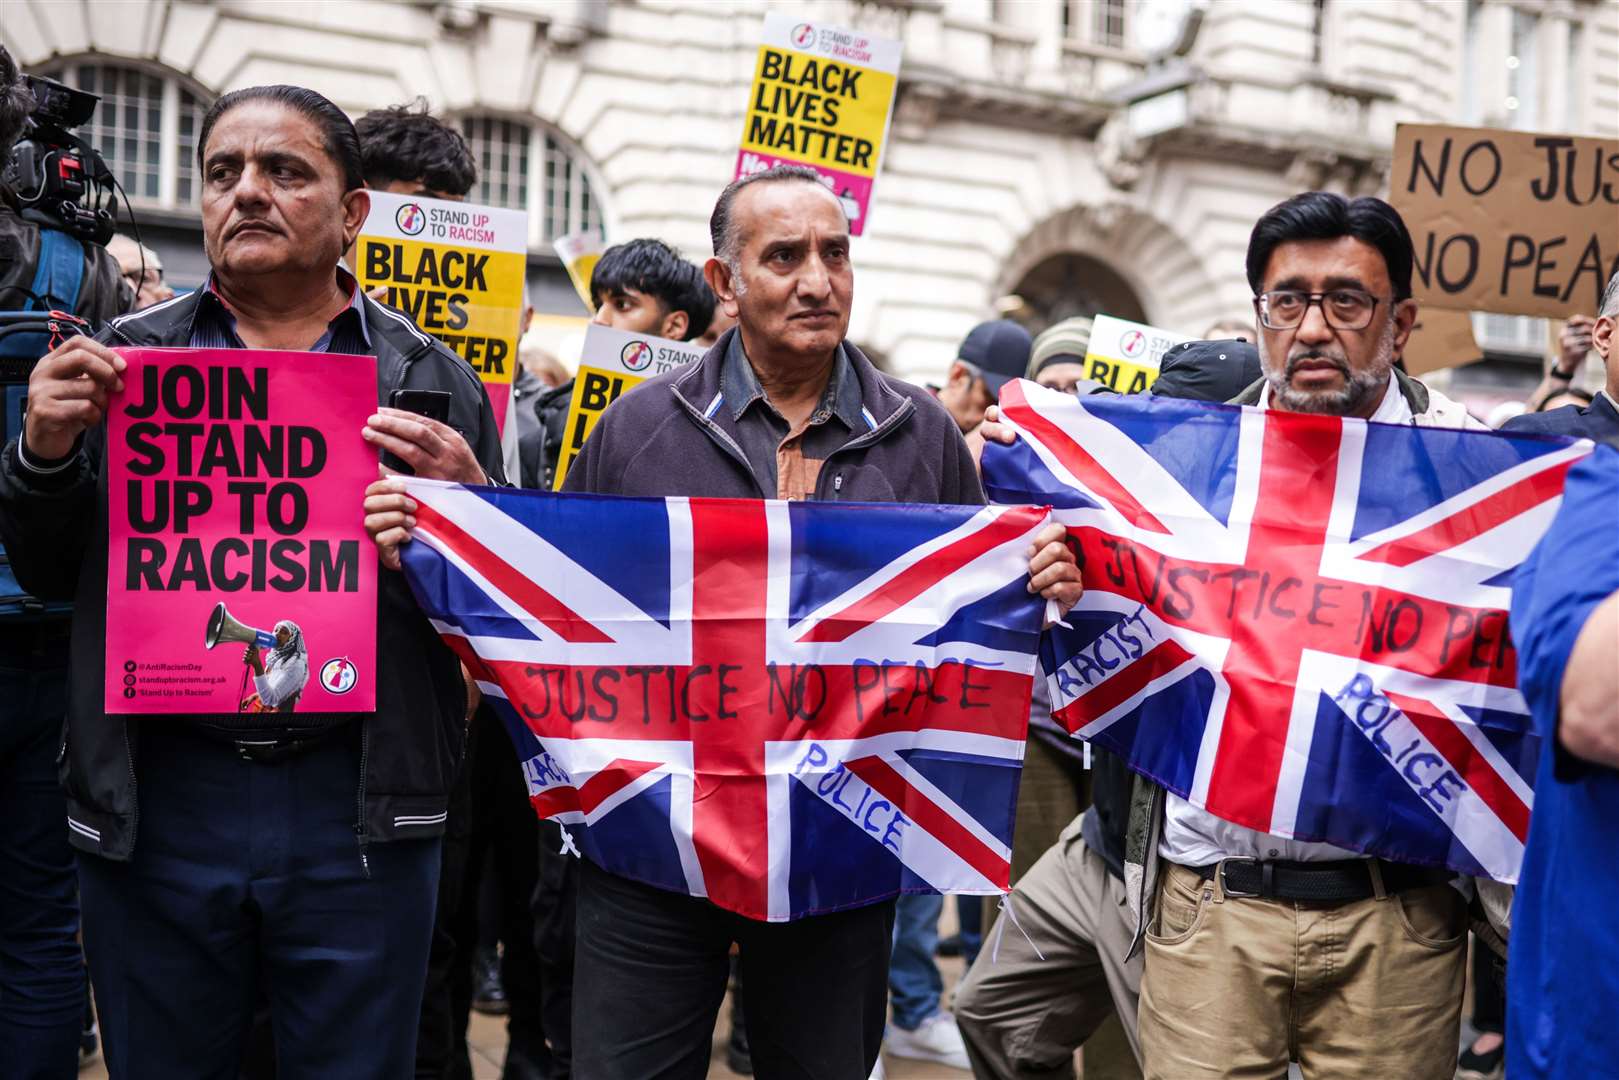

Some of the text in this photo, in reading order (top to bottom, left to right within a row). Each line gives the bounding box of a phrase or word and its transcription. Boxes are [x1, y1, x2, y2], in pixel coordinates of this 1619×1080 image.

[761, 50, 863, 99] BLACK
[755, 83, 840, 126] LIVES
[748, 115, 873, 168] MATTER
[1408, 138, 1502, 197] NO
[430, 208, 489, 228] STAND UP
[430, 223, 495, 244] TO RACISM
[365, 241, 492, 292] BLACK
[1500, 232, 1619, 305] PEA
[365, 284, 470, 330] IVES
[437, 332, 508, 375] TER
[124, 364, 268, 420] JOIN
[125, 422, 328, 478] STAND
[127, 480, 309, 535] UP TO
[126, 537, 360, 593] RACISM
[1101, 537, 1343, 627] JUSTICE
[1354, 591, 1423, 653] NO
[1057, 603, 1155, 698] RACIST
[522, 657, 1004, 725] JUSTICE NO PEACE
[1336, 672, 1468, 814] POLICE
[795, 742, 911, 852] POLICE
